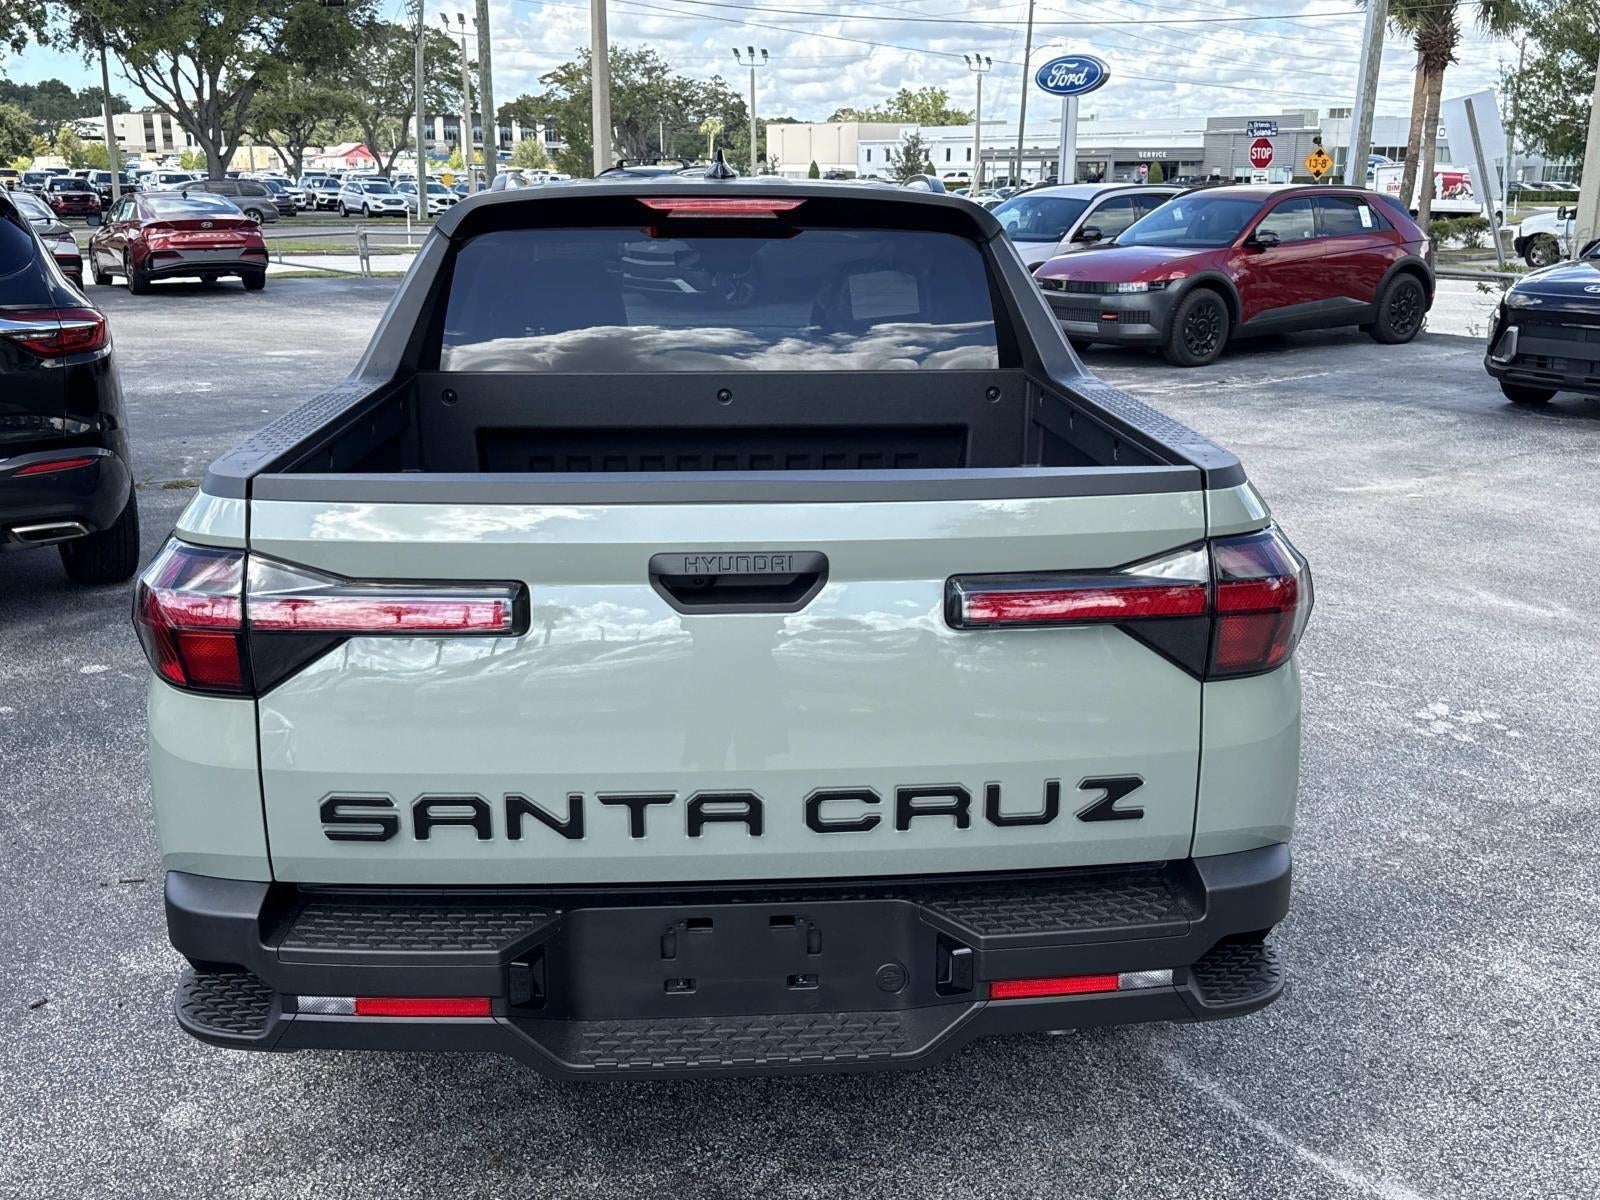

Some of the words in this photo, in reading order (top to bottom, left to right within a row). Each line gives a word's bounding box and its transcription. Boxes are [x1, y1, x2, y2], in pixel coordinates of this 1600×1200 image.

[1047, 62, 1090, 88] Ford
[1138, 151, 1168, 159] SERVICE
[1251, 147, 1272, 160] STOP
[684, 555, 793, 574] HYUNDAI
[318, 788, 764, 842] SANTA
[803, 773, 1146, 834] CRUZ
